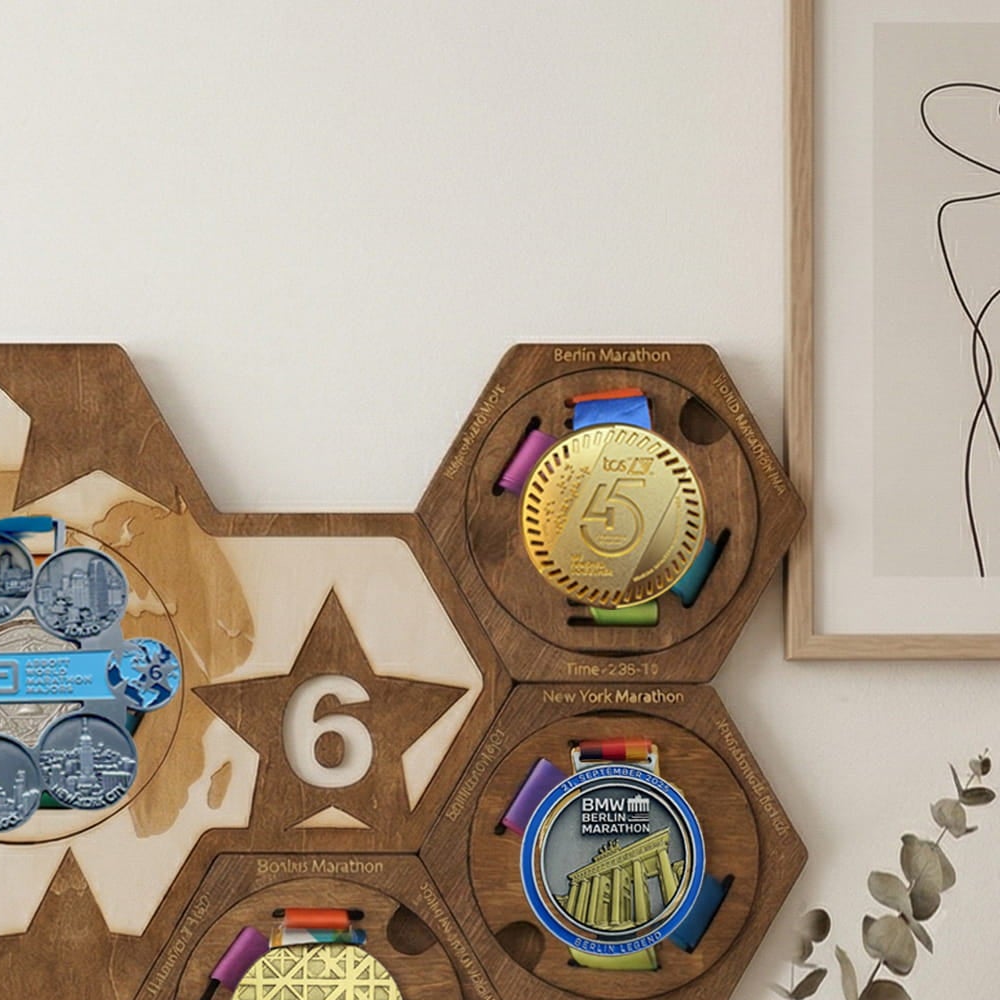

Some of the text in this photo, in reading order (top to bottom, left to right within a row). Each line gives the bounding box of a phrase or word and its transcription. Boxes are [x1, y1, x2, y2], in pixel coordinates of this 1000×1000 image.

[600, 347, 672, 362] Marathon
[149, 664, 163, 680] 6
[543, 688, 685, 704] New York Marathon
[282, 673, 374, 789] 6
[578, 766, 642, 780] SEPTEMBER
[582, 798, 624, 812] BMW
[582, 813, 626, 822] BERLIN
[582, 823, 650, 834] MARATHON
[574, 931, 662, 953] BERLIN LEGEND
